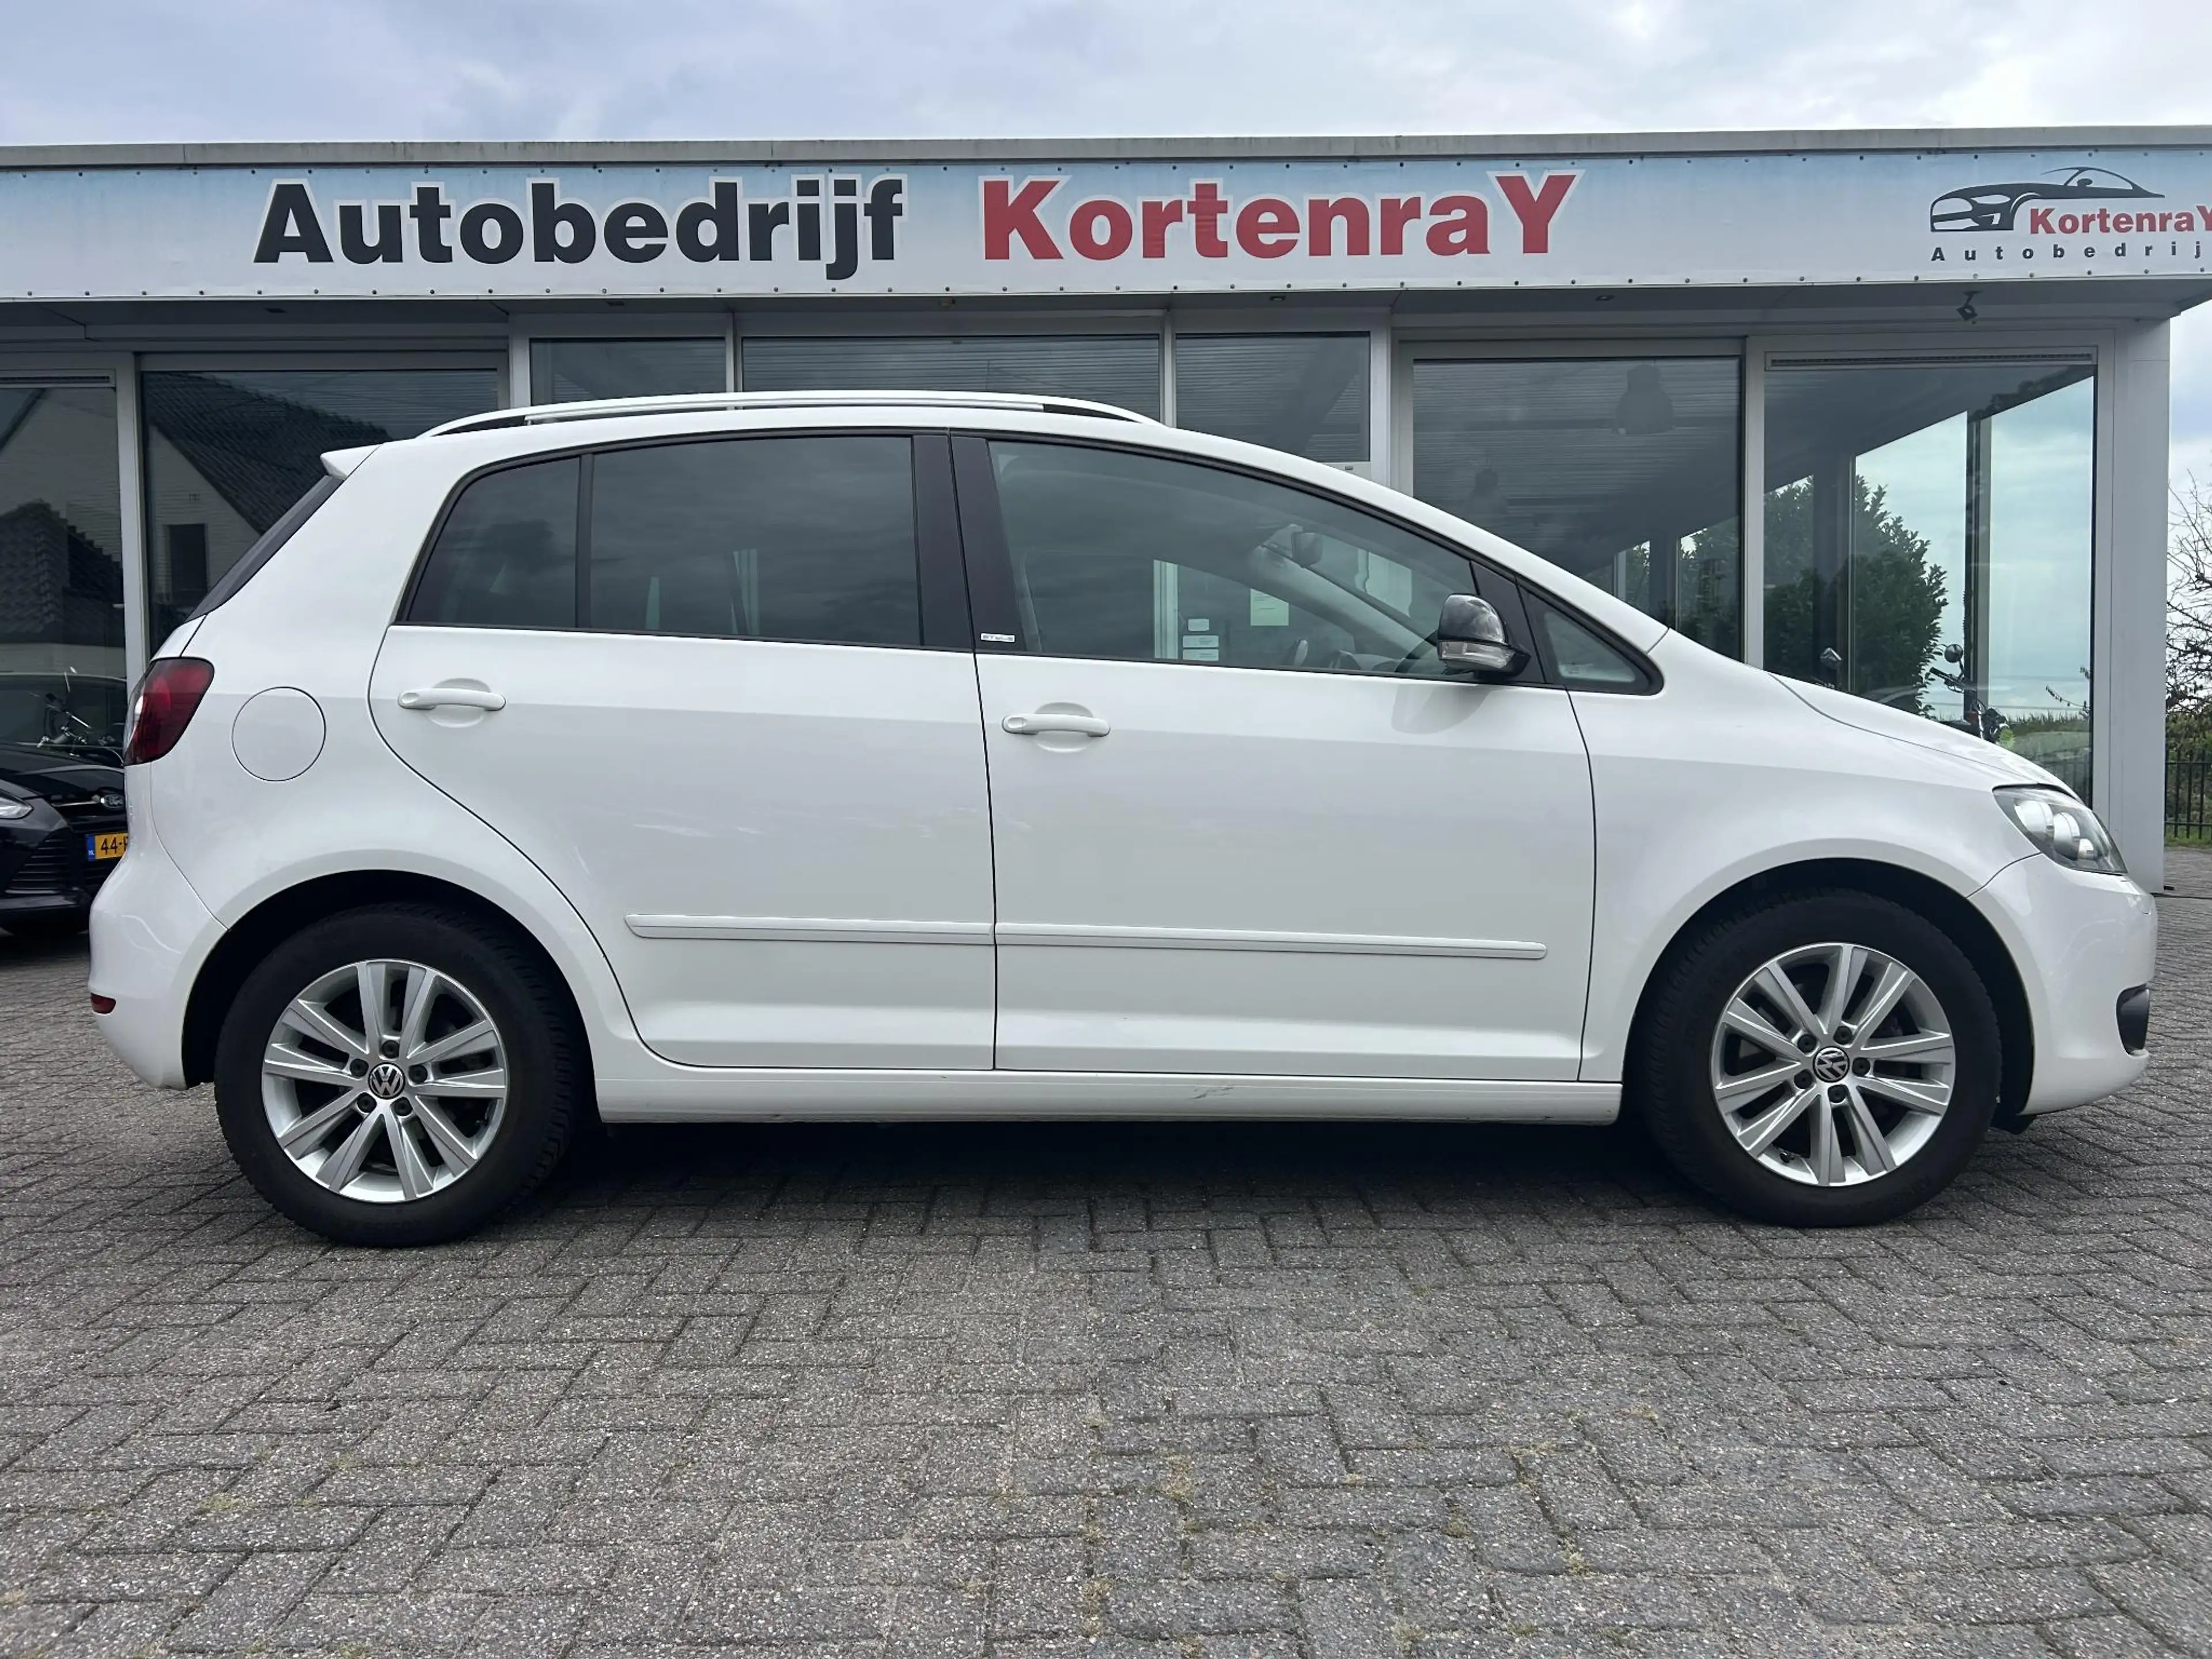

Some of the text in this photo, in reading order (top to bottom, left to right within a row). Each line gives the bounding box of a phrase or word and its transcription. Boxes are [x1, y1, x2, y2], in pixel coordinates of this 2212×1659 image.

[253, 175, 1577, 281] Autobedrijf KortenraY
[2029, 205, 2212, 234] KortenraY
